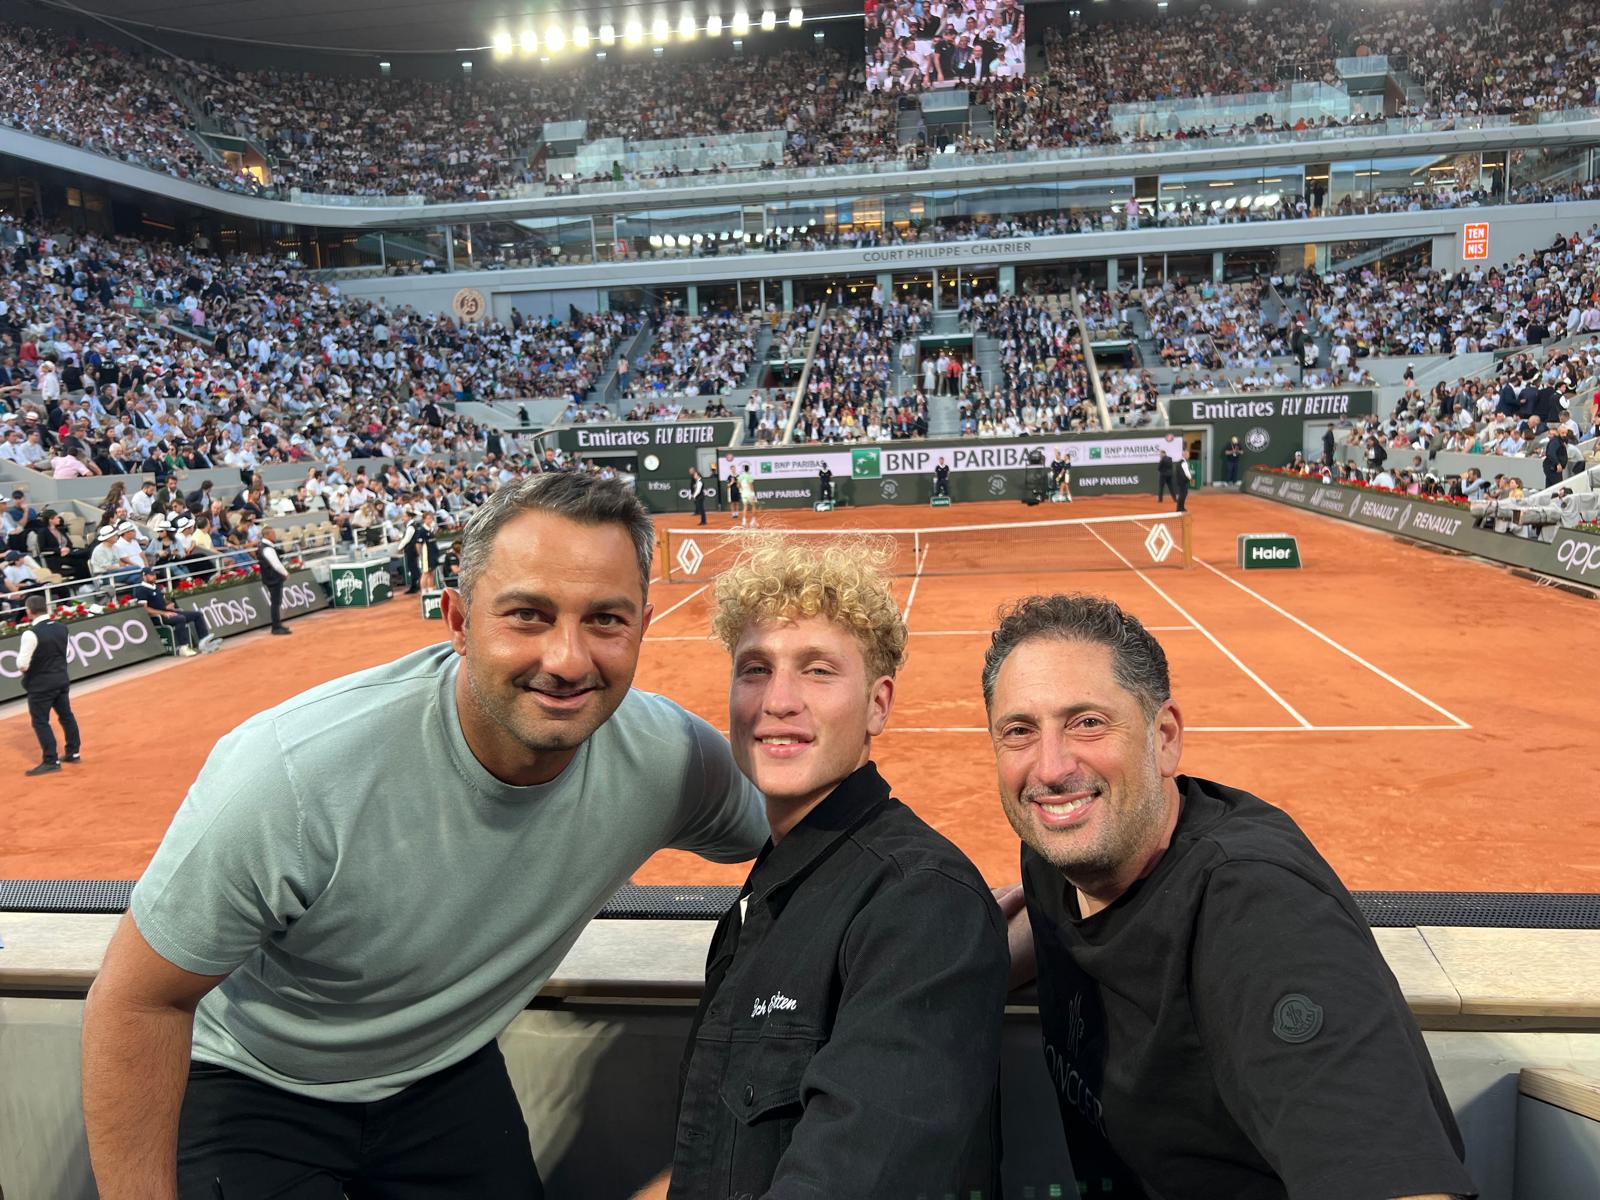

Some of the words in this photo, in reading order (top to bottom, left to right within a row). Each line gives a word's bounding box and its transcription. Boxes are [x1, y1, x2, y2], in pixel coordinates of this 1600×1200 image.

[1468, 228, 1485, 239] TEN
[863, 250, 904, 262] COURT
[907, 246, 960, 259] PHILIPPE
[971, 242, 1032, 255] CHATRIER
[1467, 243, 1484, 255] NIS
[1192, 400, 1274, 420] Emirates
[1281, 397, 1302, 416] FLY
[1304, 395, 1349, 414] BETTER
[577, 429, 650, 446] Emirates
[655, 427, 673, 444] FLY
[675, 426, 714, 443] BETTER
[1104, 447, 1122, 455] BNP
[1124, 445, 1160, 454] PARIBAS
[886, 452, 930, 471] BNP
[1079, 477, 1099, 486] BNP
[1100, 475, 1139, 485] PARIBAS
[679, 488, 717, 500] opo
[757, 490, 774, 499] BNP
[775, 489, 811, 499] PARIBAS
[1361, 501, 1399, 521] RENAULT
[1412, 512, 1462, 536] RENAULT
[1252, 546, 1291, 560] Haier
[261, 582, 316, 609] Iosys
[1043, 1036, 1108, 1139] ONCLER
